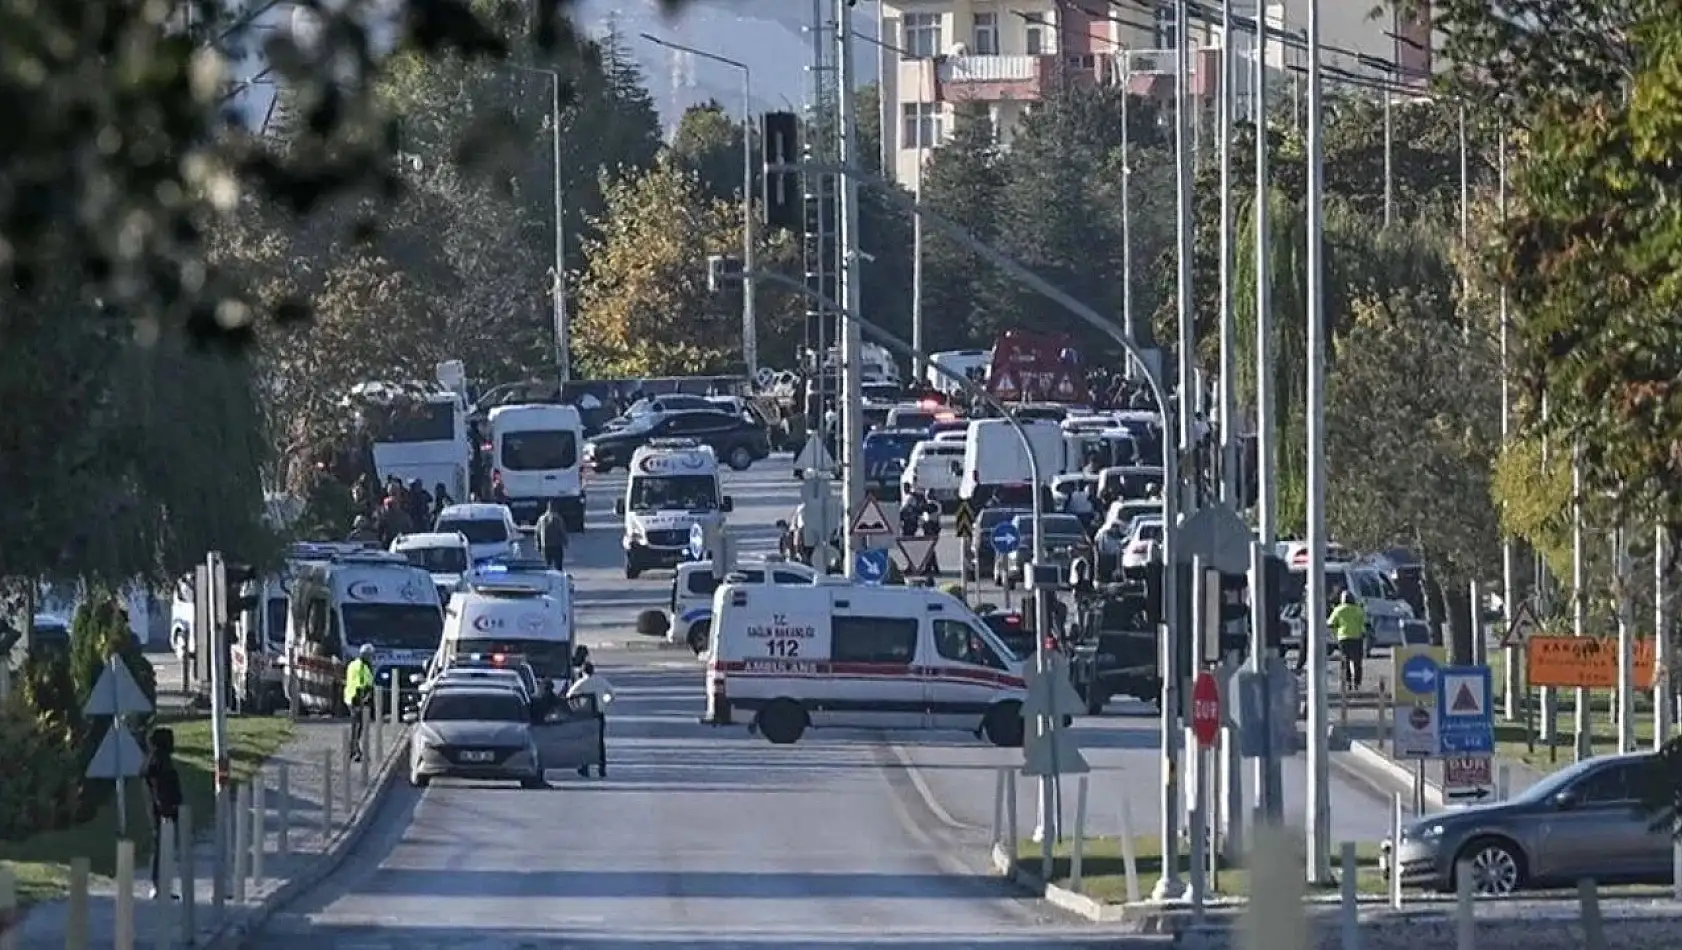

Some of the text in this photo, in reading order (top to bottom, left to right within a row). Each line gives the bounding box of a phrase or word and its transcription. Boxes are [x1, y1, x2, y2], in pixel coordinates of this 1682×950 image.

[766, 639, 799, 657] 112
[1195, 700, 1217, 719] DUR
[1449, 757, 1485, 770] DUR
